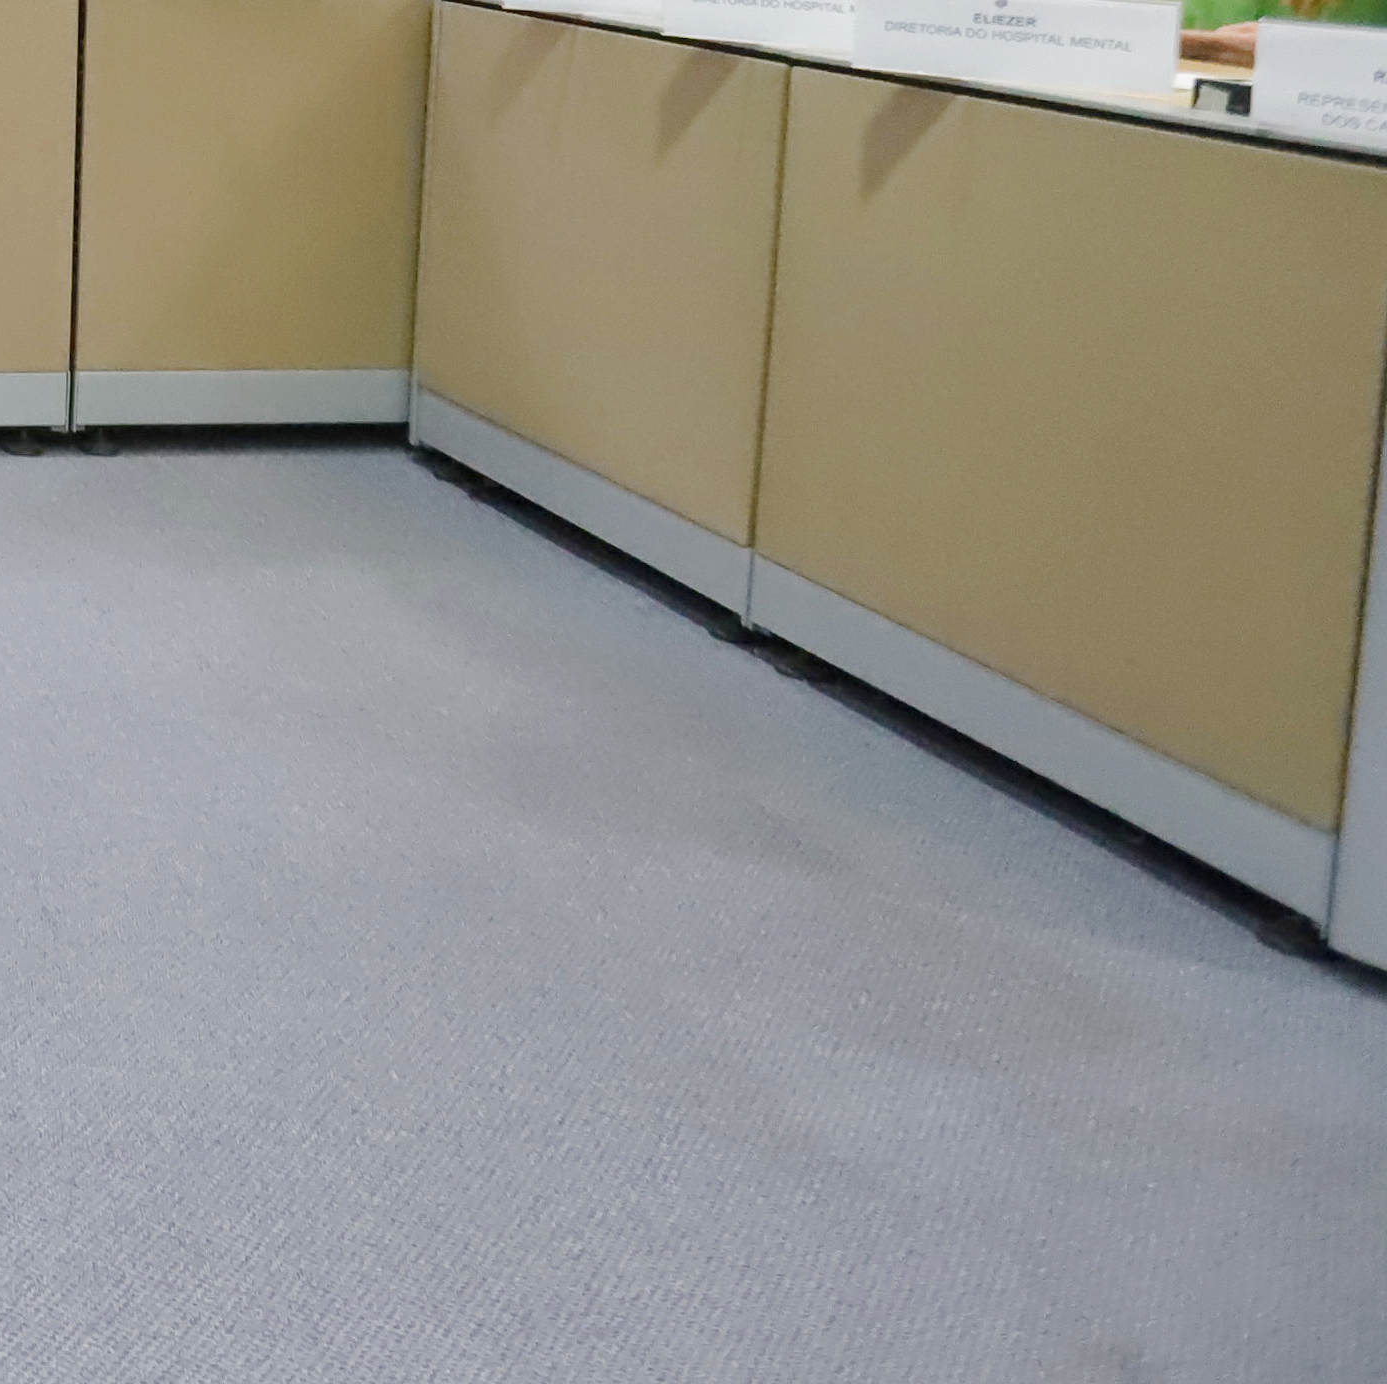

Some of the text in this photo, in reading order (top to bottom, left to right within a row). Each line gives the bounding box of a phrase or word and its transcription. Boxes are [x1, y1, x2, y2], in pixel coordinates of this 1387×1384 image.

[783, 0, 846, 14] HOSPITAL
[973, 13, 1037, 28] ELIEZER
[884, 20, 1133, 52] DIRETORIA DO HOSPITAL MENTAL
